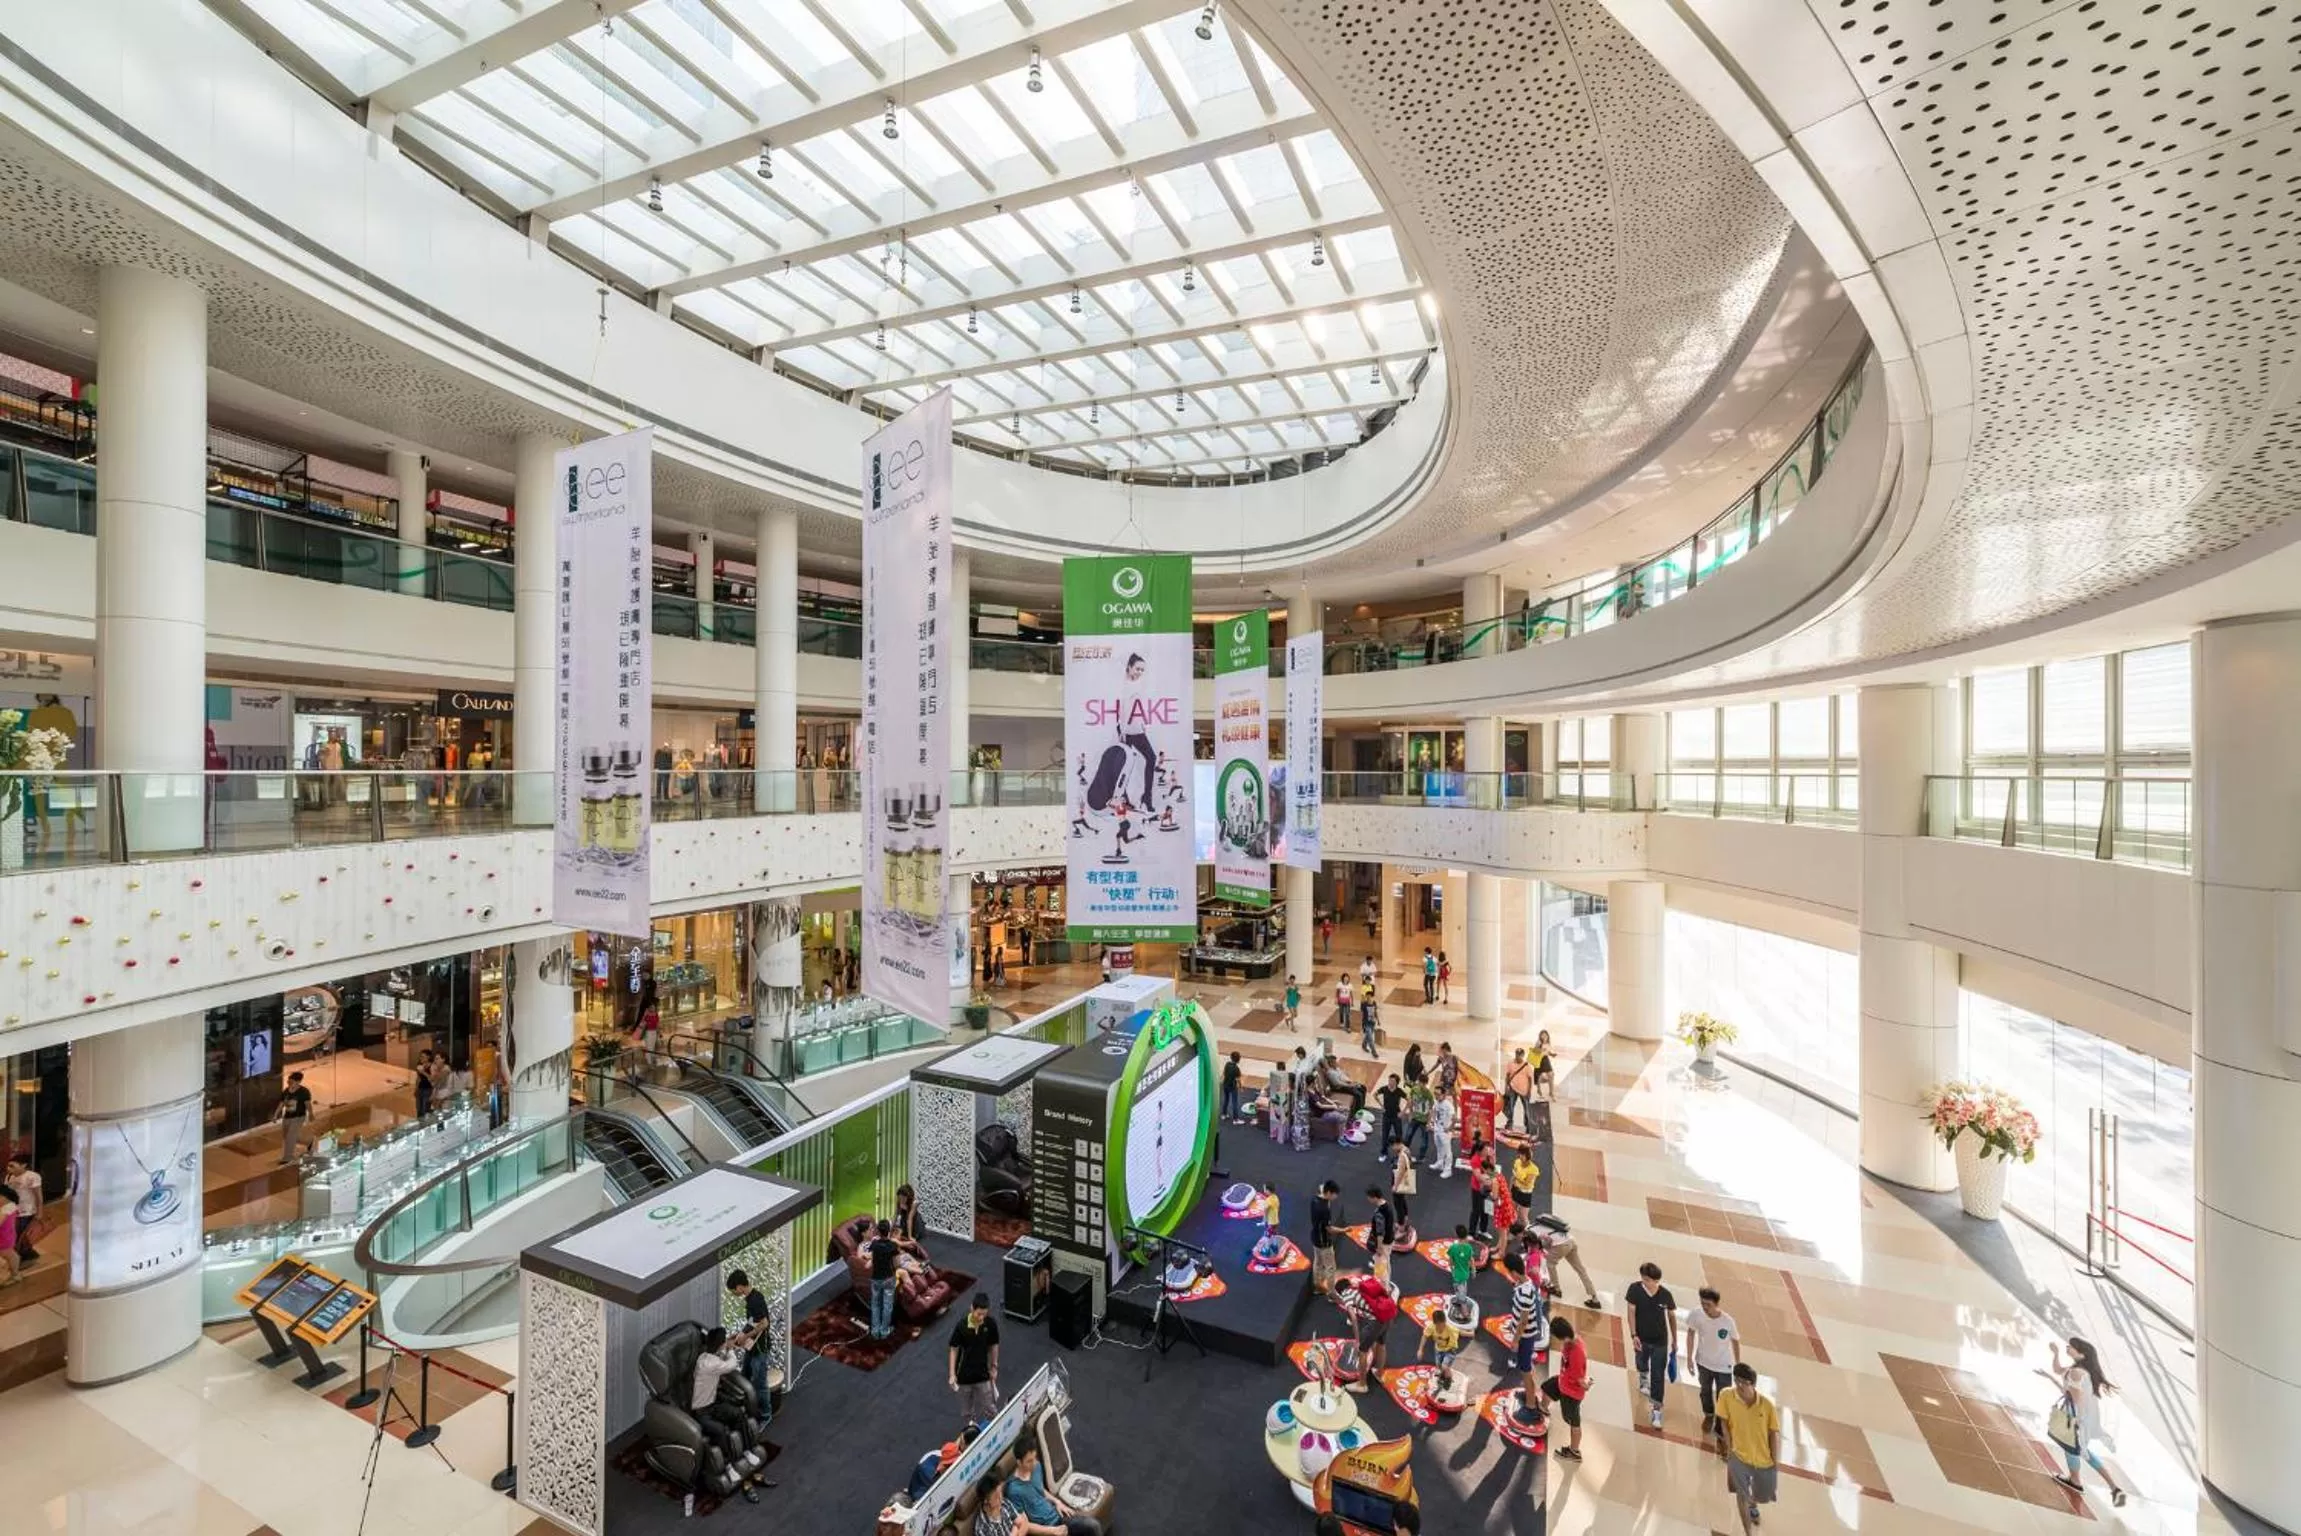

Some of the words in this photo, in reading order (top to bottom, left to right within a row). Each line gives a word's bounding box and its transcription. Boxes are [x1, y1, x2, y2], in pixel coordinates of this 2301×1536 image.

[1102, 602, 1153, 614] OGAWA
[1085, 698, 1179, 726] SHAKE
[1347, 1456, 1389, 1476] BURN
